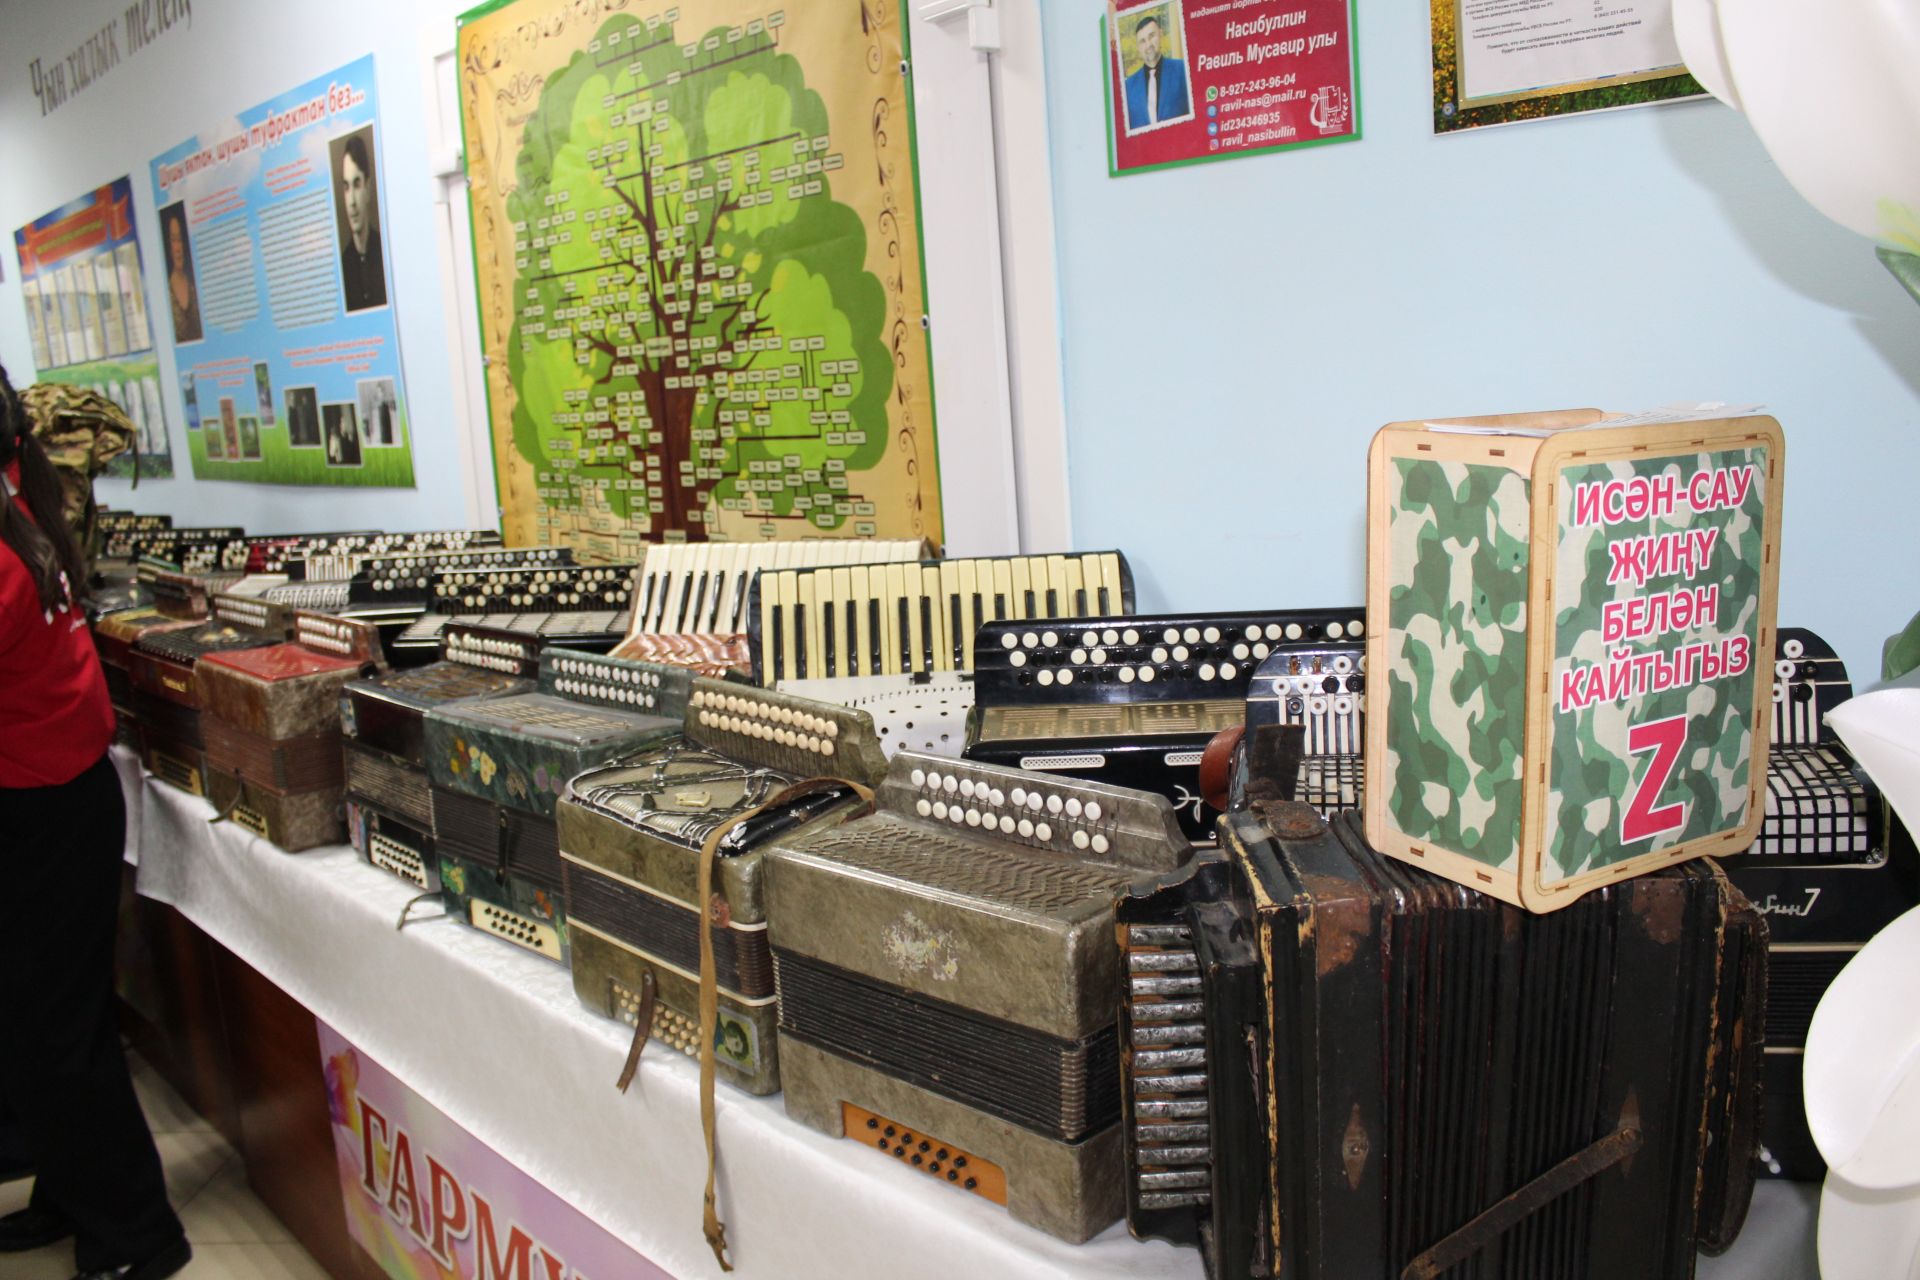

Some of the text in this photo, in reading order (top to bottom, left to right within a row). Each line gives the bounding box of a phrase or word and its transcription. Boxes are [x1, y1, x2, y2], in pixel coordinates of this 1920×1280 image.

[1225, 9, 1307, 40] Насибуллин
[1197, 31, 1337, 72] Равиль Мусавир улы
[1219, 73, 1296, 98] 8-927-243-96-04
[1220, 89, 1307, 113] ravil-nas@mail.ru
[1220, 112, 1281, 132] id234346935
[1221, 125, 1296, 148] ravil_nasibullin
[1574, 466, 1753, 528] ИСӘН-САУ
[1608, 527, 1719, 587] ҖИҢҮ
[1601, 584, 1719, 646] БЕЛӘН
[1559, 633, 1751, 714] КАЙТЫГЫЗ
[1620, 712, 1689, 845] Z
